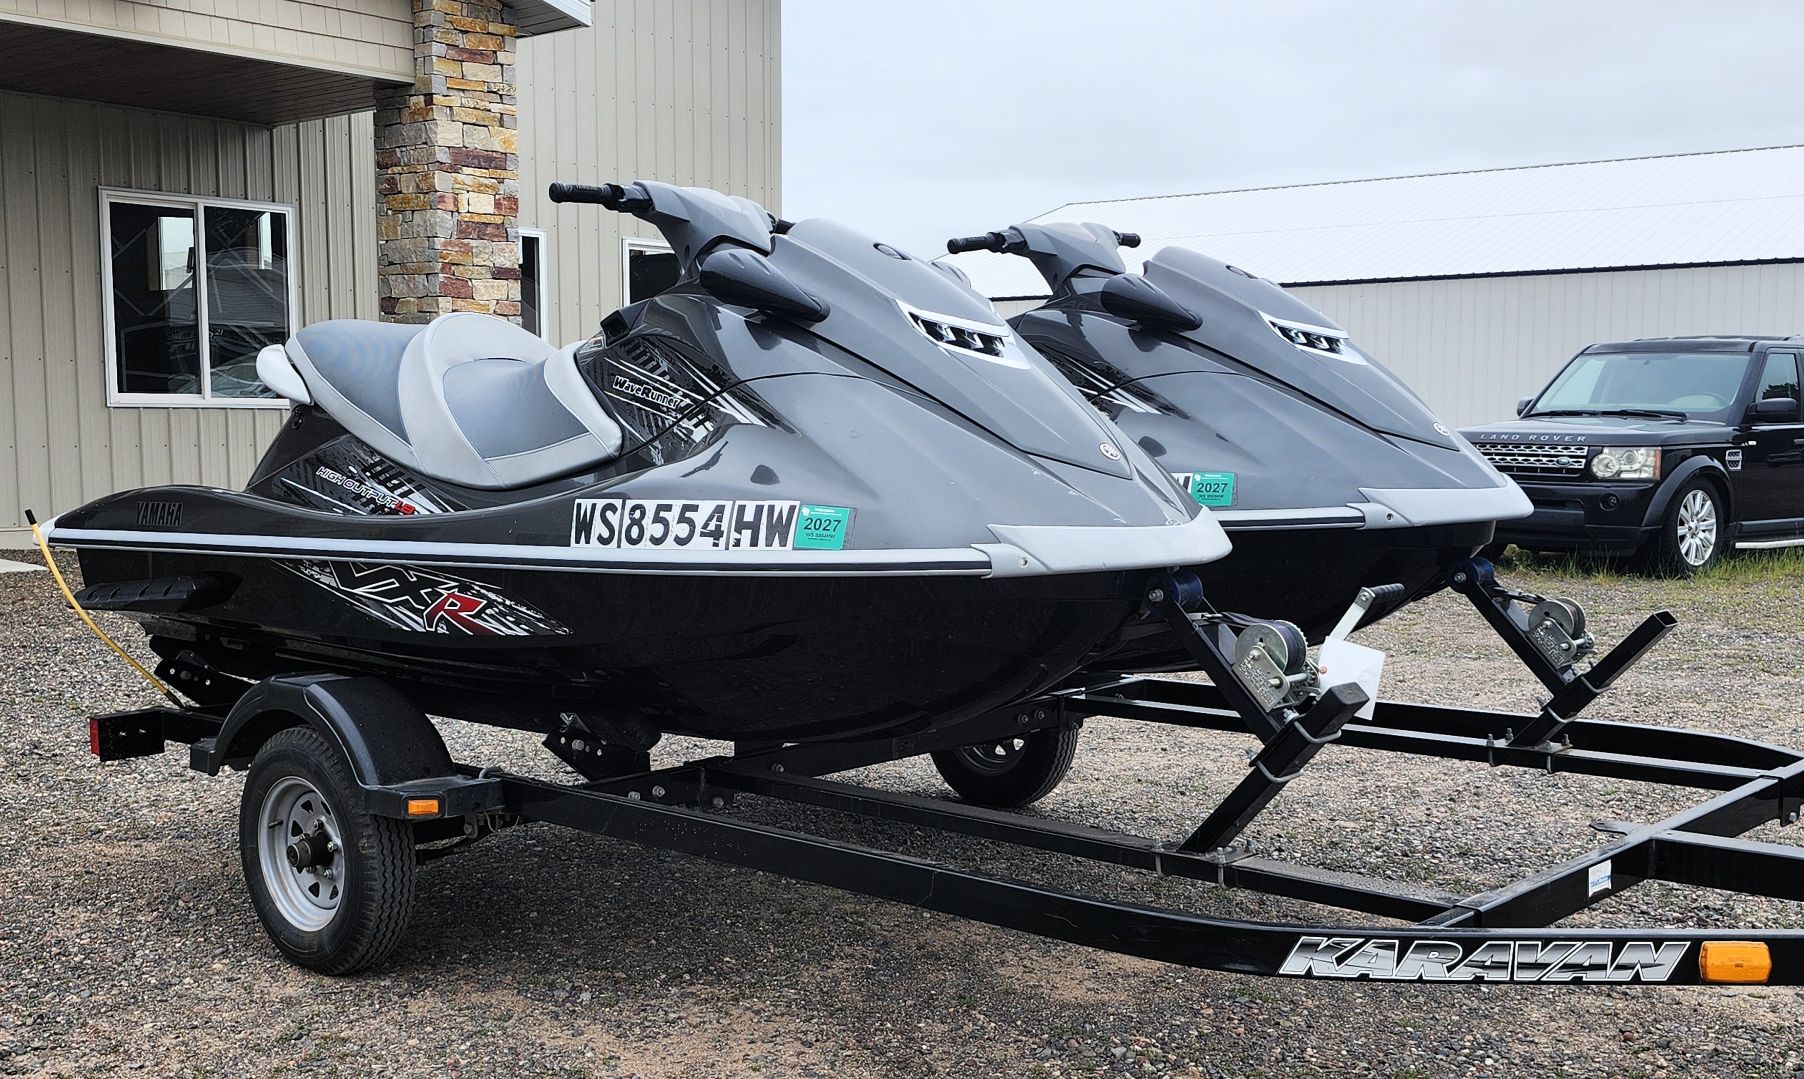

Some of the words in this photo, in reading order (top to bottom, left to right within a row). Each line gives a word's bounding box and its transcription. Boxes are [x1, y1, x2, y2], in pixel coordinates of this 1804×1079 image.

[612, 375, 682, 409] WaveRunner
[1529, 434, 1587, 442] ROVER
[316, 466, 347, 486] HIGH
[343, 478, 398, 509] OUTPUT
[1196, 482, 1228, 493] 2027
[136, 502, 184, 526] YAMAHA
[803, 517, 842, 532] 2027
[1279, 936, 1692, 982] KARAVAN
